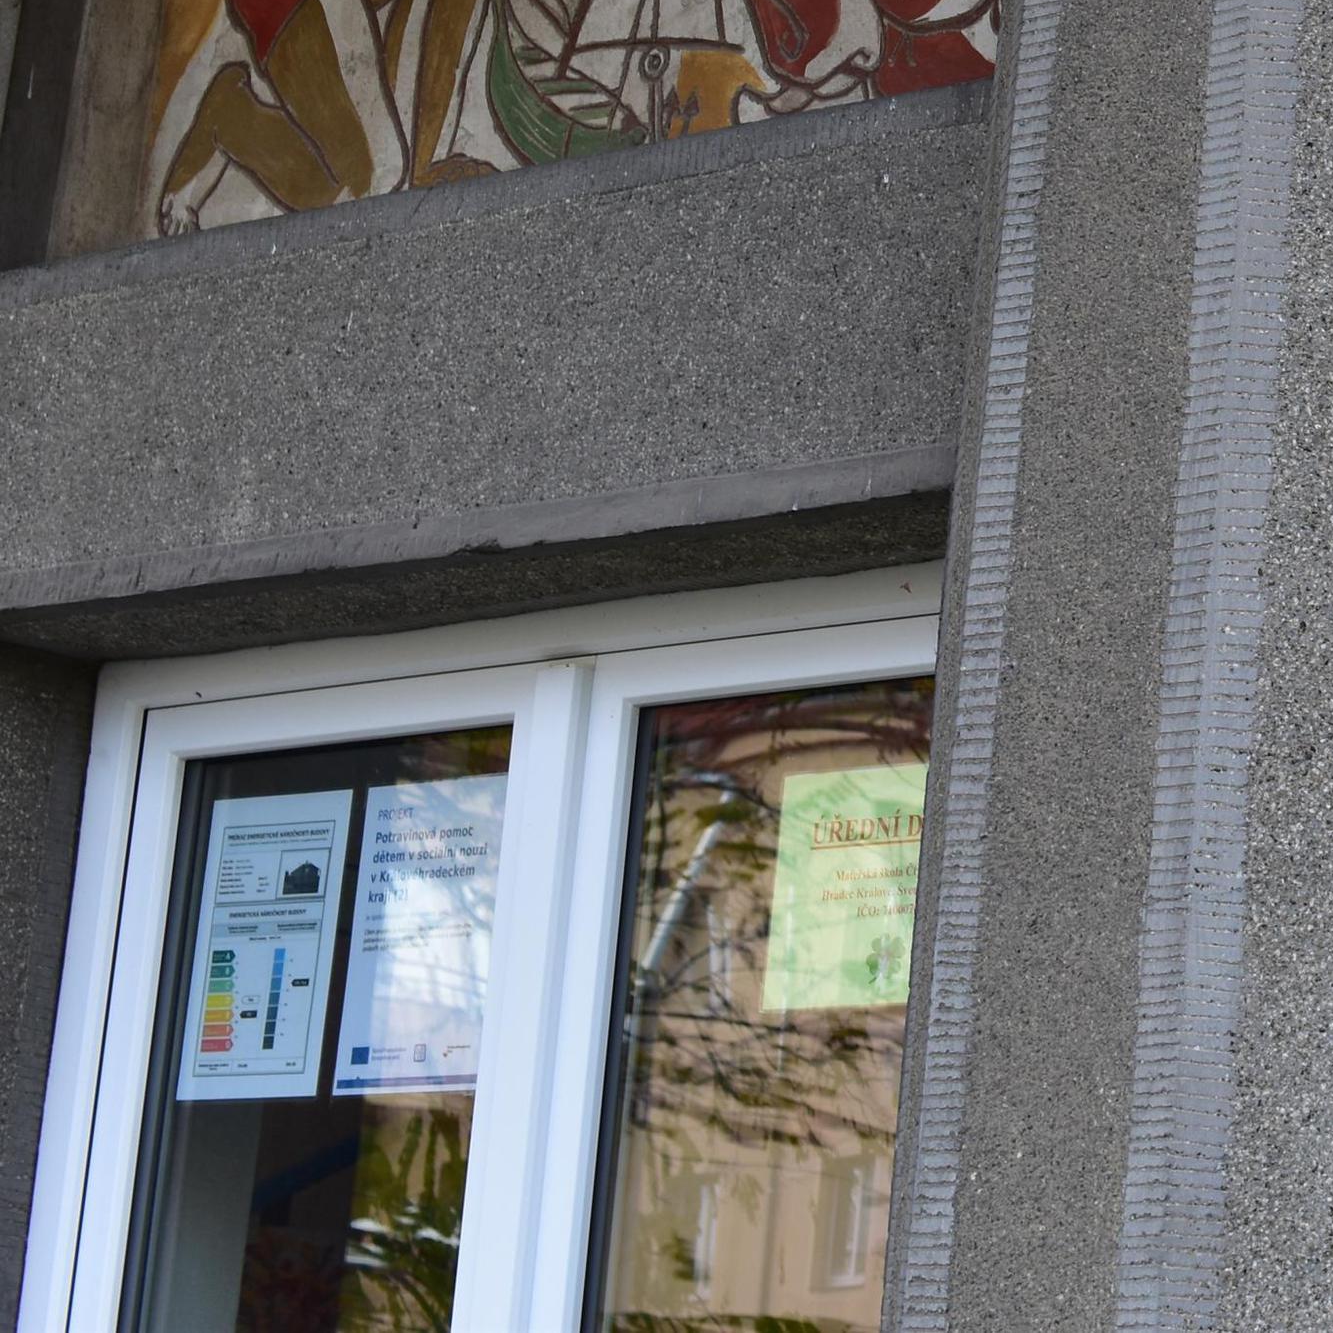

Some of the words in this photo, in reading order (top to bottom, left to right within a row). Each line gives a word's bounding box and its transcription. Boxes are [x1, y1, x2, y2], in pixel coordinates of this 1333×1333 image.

[376, 827, 437, 844] Potravinová
[813, 808, 903, 844] ÚŘEDNÍ
[373, 852, 405, 864] dětem
[408, 852, 416, 861] v
[459, 843, 488, 858] nouzi
[370, 873, 377, 883] v
